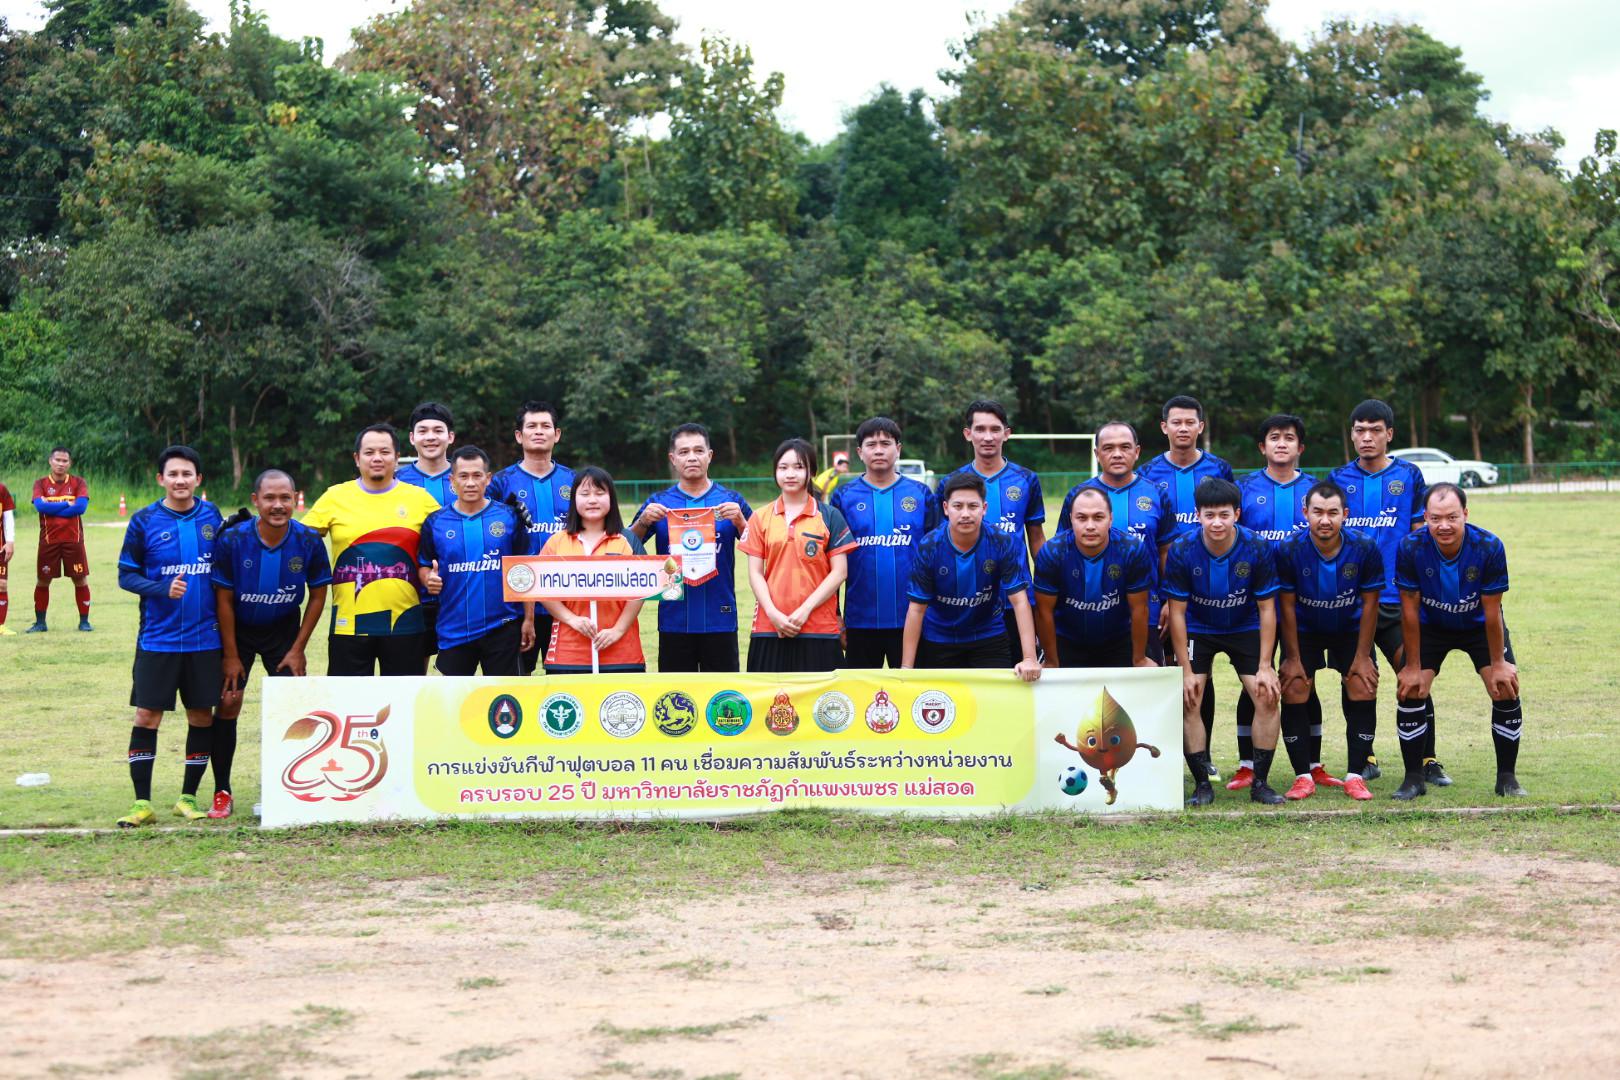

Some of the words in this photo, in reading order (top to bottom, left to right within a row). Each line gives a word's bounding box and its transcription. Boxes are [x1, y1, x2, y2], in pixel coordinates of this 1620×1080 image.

[73, 563, 84, 574] 45
[540, 568, 658, 588] เทศบาลนครแม่สอด
[427, 756, 635, 778] การแข่งขันกีฬาฟุตบอล
[641, 757, 656, 771] 11
[661, 757, 688, 771] คน
[694, 747, 1013, 771] เชื่อมความสัมพันธ์ระหว่างหน่วยงาน
[460, 785, 542, 802] ครบรอบ
[548, 784, 575, 801] 25
[581, 781, 596, 800] ปี
[602, 777, 898, 802] มหาวิทยาลัยราชภัฏกำแพงเพชร
[905, 776, 975, 796] แม่สอด
